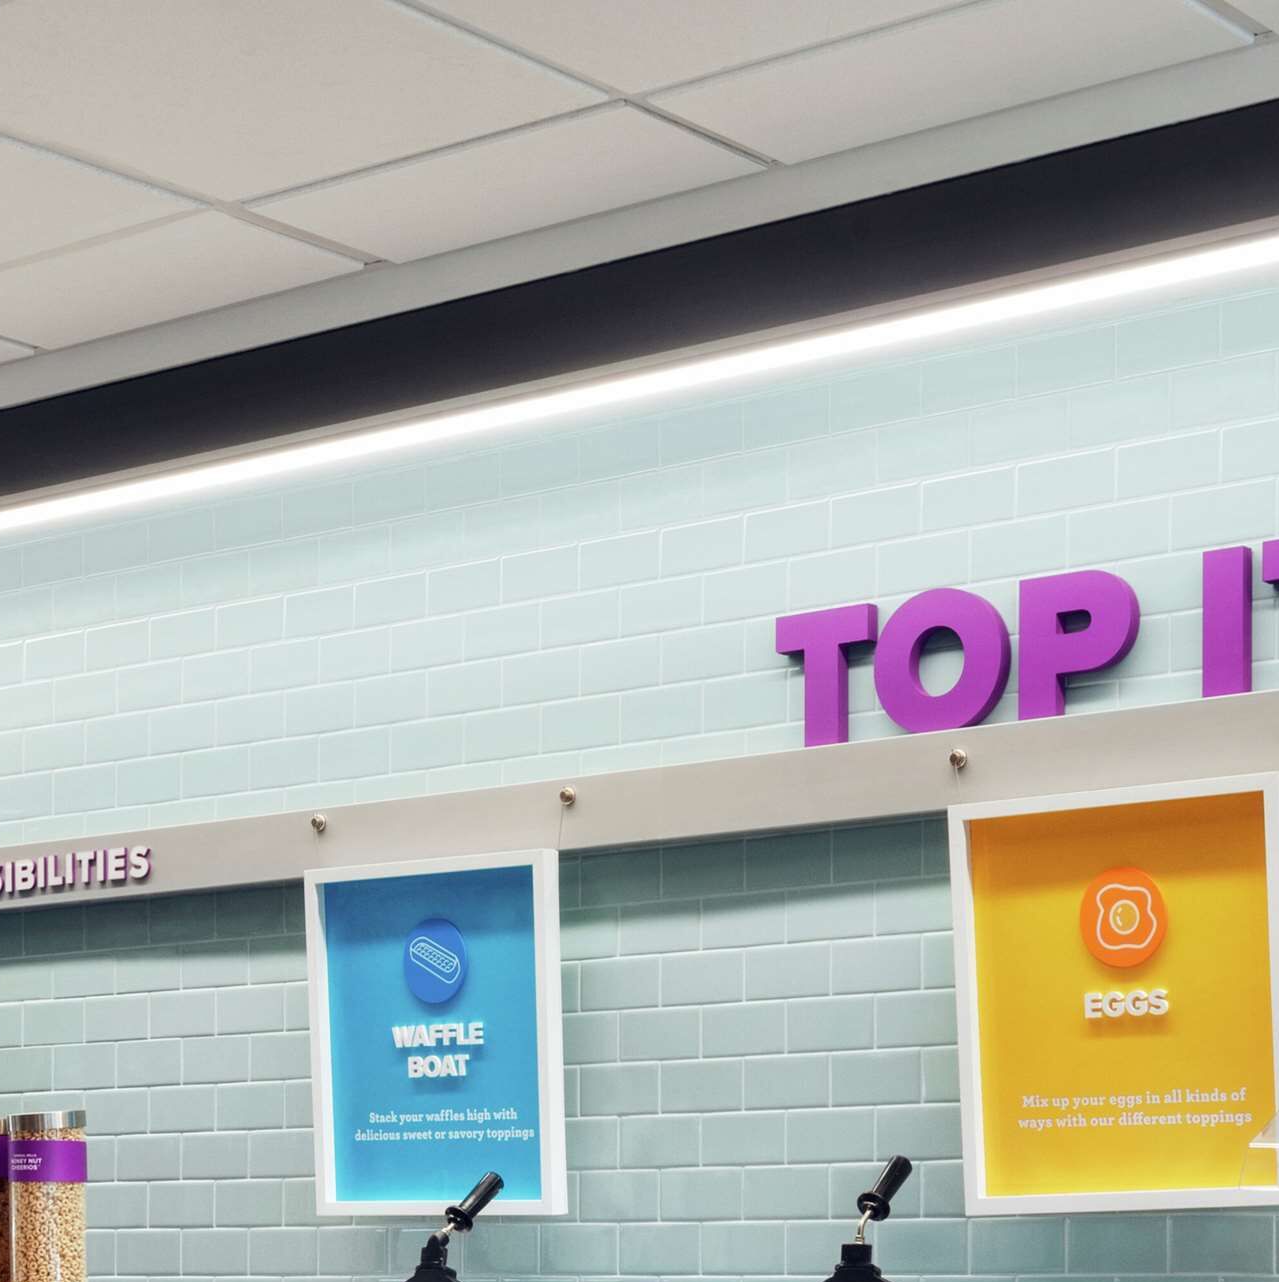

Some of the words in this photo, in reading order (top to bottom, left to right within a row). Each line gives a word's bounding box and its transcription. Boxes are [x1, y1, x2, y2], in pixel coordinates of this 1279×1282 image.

[776, 569, 1141, 748] TOP
[1084, 988, 1170, 1019] EGGS
[392, 1022, 485, 1048] WAFFLE
[407, 1054, 470, 1078] BOAT
[1022, 1095, 1049, 1107] Mix
[1052, 1095, 1070, 1110] up
[1072, 1094, 1106, 1110] your
[1109, 1093, 1142, 1108] eggs
[1146, 1091, 1161, 1105] in
[1164, 1089, 1183, 1104] all
[1186, 1088, 1227, 1103] kinds
[1231, 1087, 1247, 1101] of
[369, 1111, 399, 1124] Stack
[399, 1113, 424, 1126] your
[426, 1109, 465, 1122] waffles
[467, 1109, 491, 1124] high
[492, 1108, 518, 1121] with
[1018, 1117, 1054, 1131] ways
[1056, 1113, 1087, 1128] with
[1090, 1115, 1116, 1127] our
[1118, 1111, 1183, 1127] different
[1186, 1110, 1253, 1128] toppings
[354, 1129, 400, 1142] delicious
[403, 1129, 433, 1141] sweet
[434, 1130, 446, 1140] or
[448, 1128, 485, 1142] savory
[486, 1126, 535, 1142] toppings
